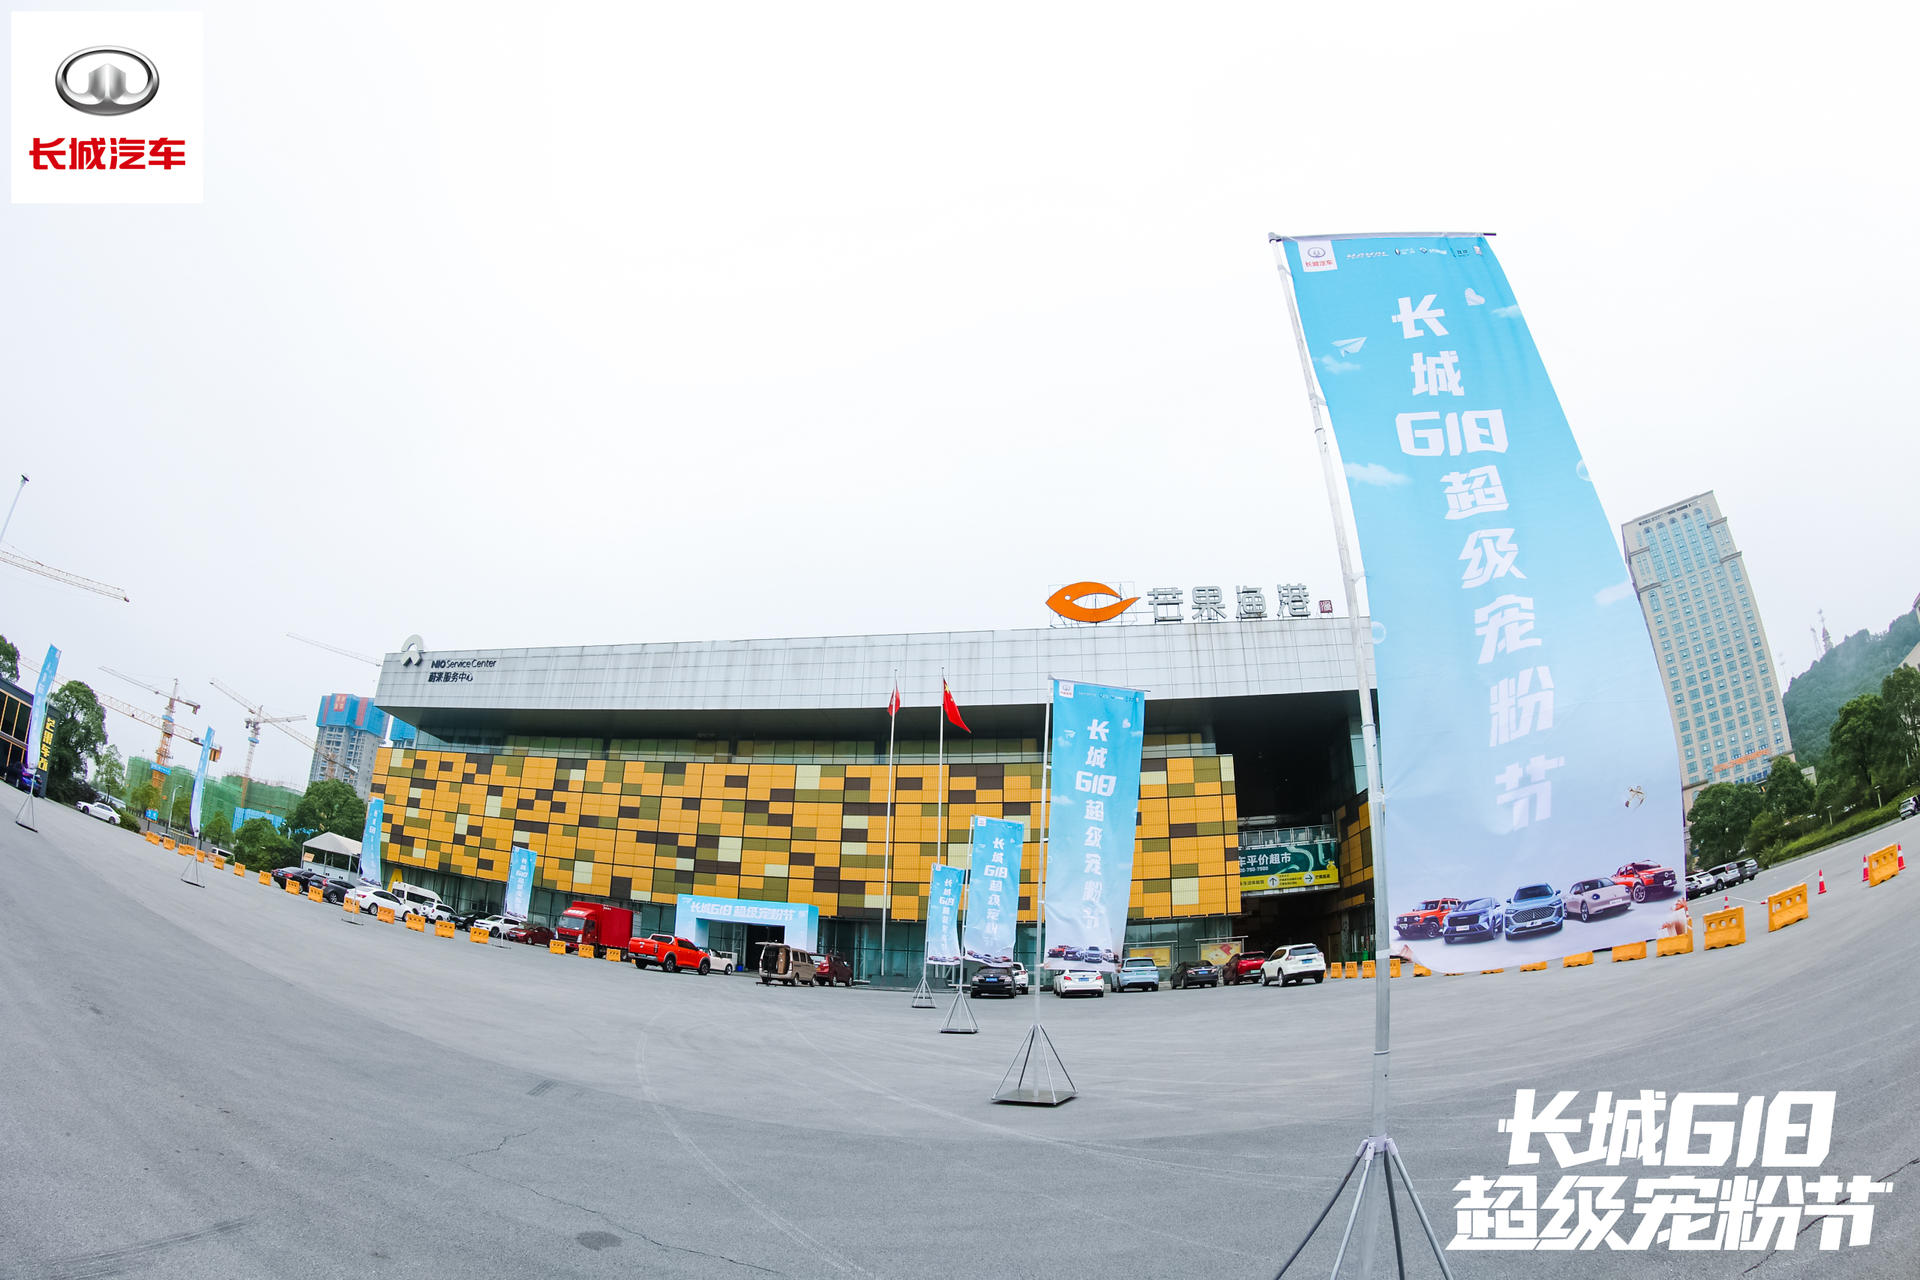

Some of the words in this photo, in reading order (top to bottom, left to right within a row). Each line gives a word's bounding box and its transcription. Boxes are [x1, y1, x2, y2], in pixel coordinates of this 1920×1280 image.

[1391, 293, 1565, 833] 长城618超级宠粉节
[431, 660, 446, 668] NIO
[447, 660, 470, 669] Service
[472, 659, 496, 668] Center
[428, 672, 474, 683] 蔚来服务中心
